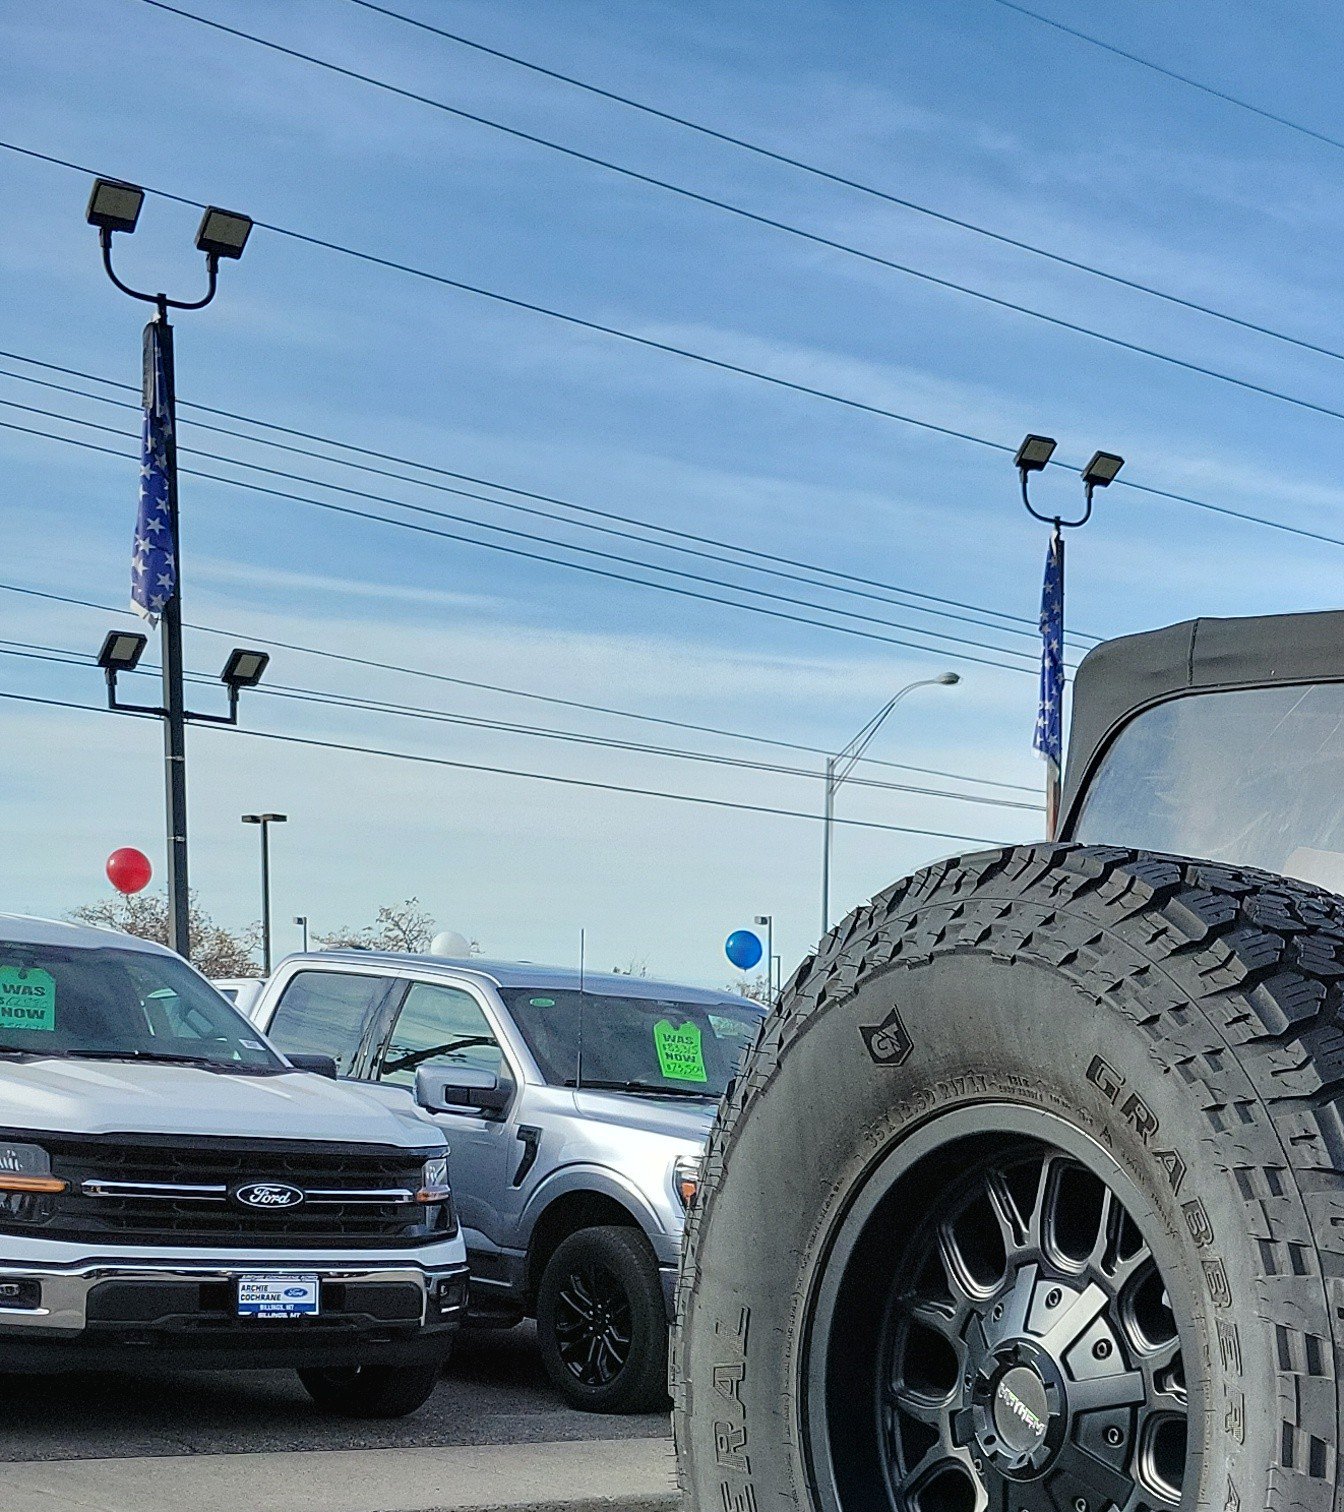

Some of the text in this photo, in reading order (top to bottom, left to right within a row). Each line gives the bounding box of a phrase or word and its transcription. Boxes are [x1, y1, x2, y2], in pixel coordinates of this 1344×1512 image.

[2, 983, 46, 997] WAS
[1, 1007, 46, 1020] NOW
[662, 1033, 694, 1045] WAS
[665, 1052, 696, 1063] NOW
[248, 1186, 292, 1205] Ford
[1085, 1053, 1247, 1446] GRABBER
[240, 1284, 269, 1292] ARCHIE
[240, 1293, 282, 1301] COCHRANE
